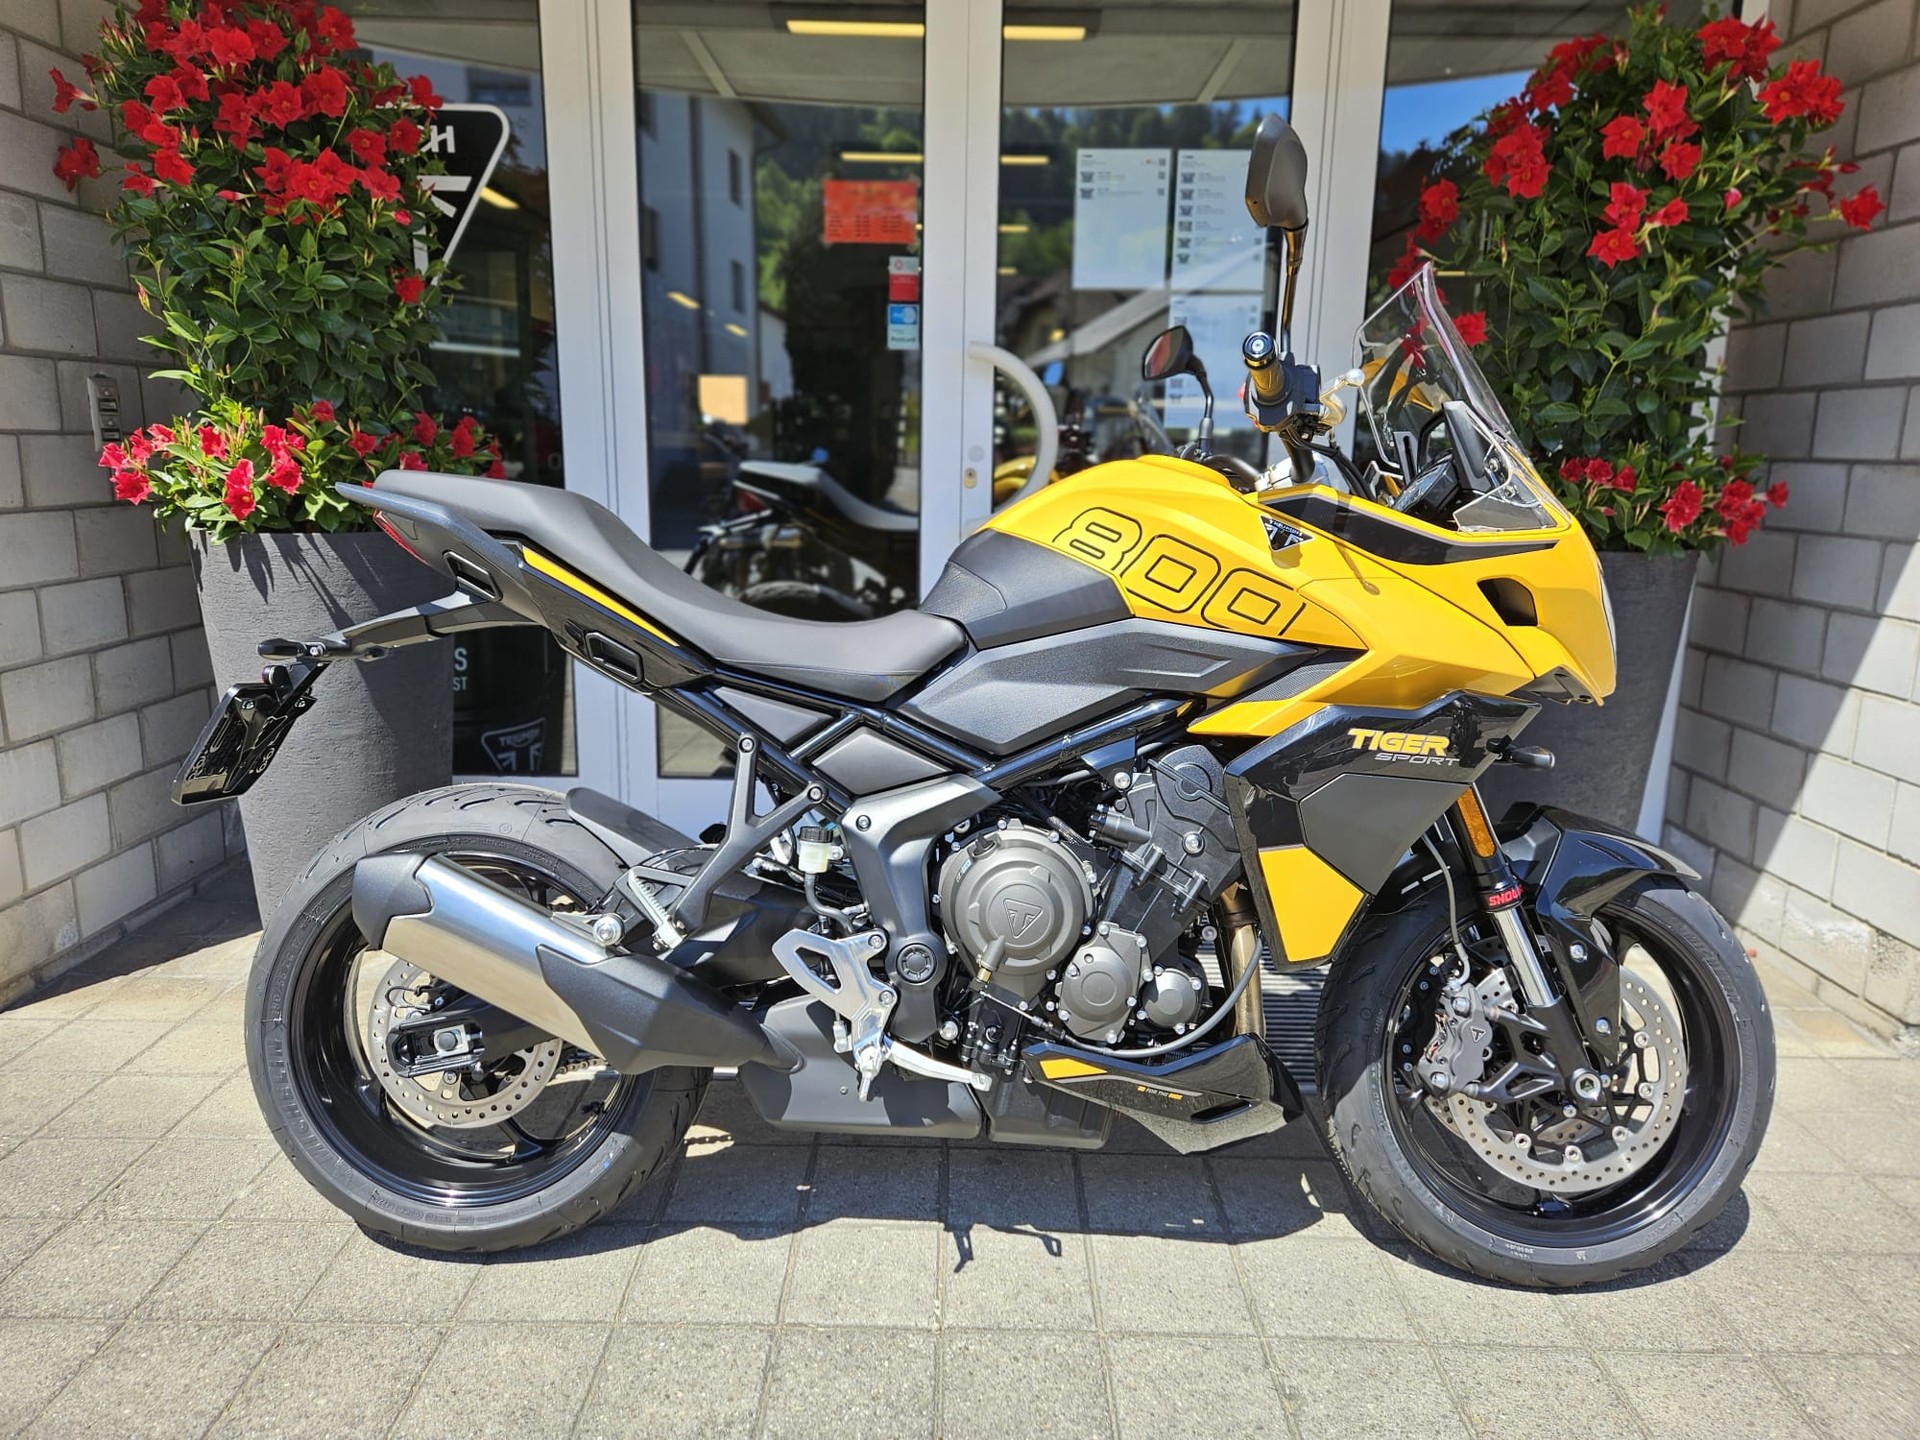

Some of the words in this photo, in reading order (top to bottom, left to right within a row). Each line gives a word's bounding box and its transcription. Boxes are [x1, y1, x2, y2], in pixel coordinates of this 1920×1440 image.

[1053, 507, 1306, 635] 800
[1347, 727, 1450, 757] TIGER
[1374, 751, 1461, 766] SPORT
